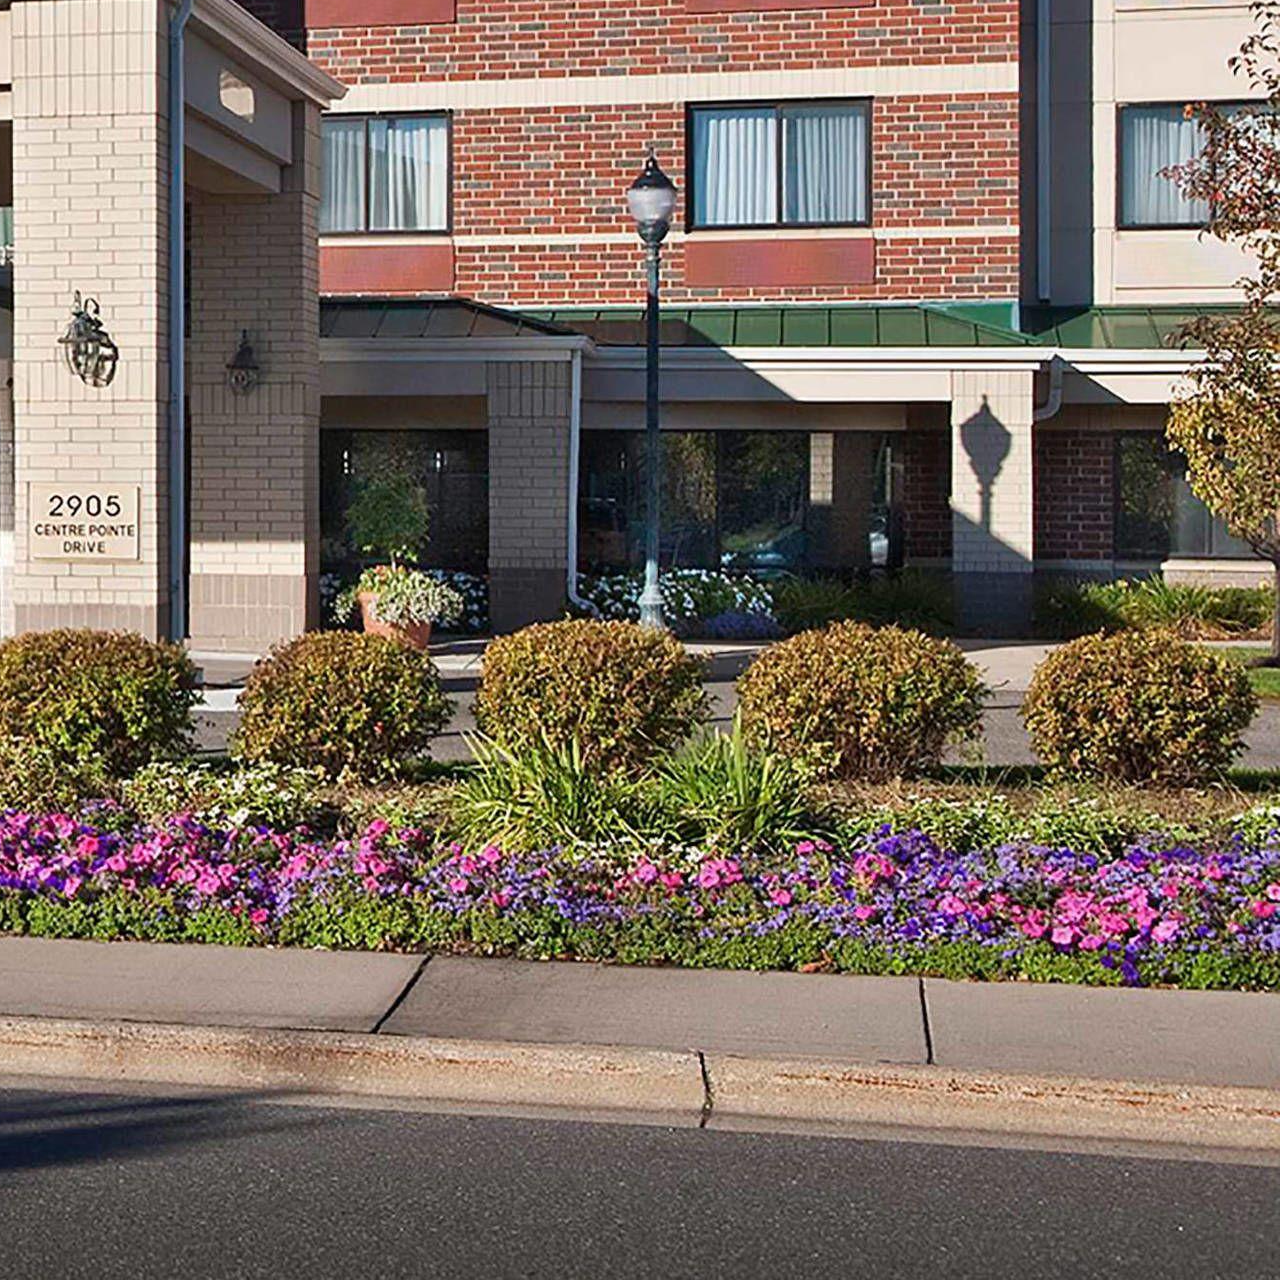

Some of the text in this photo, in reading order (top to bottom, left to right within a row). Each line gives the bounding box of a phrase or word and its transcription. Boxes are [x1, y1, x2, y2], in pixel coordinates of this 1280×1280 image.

[49, 495, 121, 517] 2905
[34, 524, 135, 537] CENTRE POINTE
[63, 541, 106, 554] DRIVE
